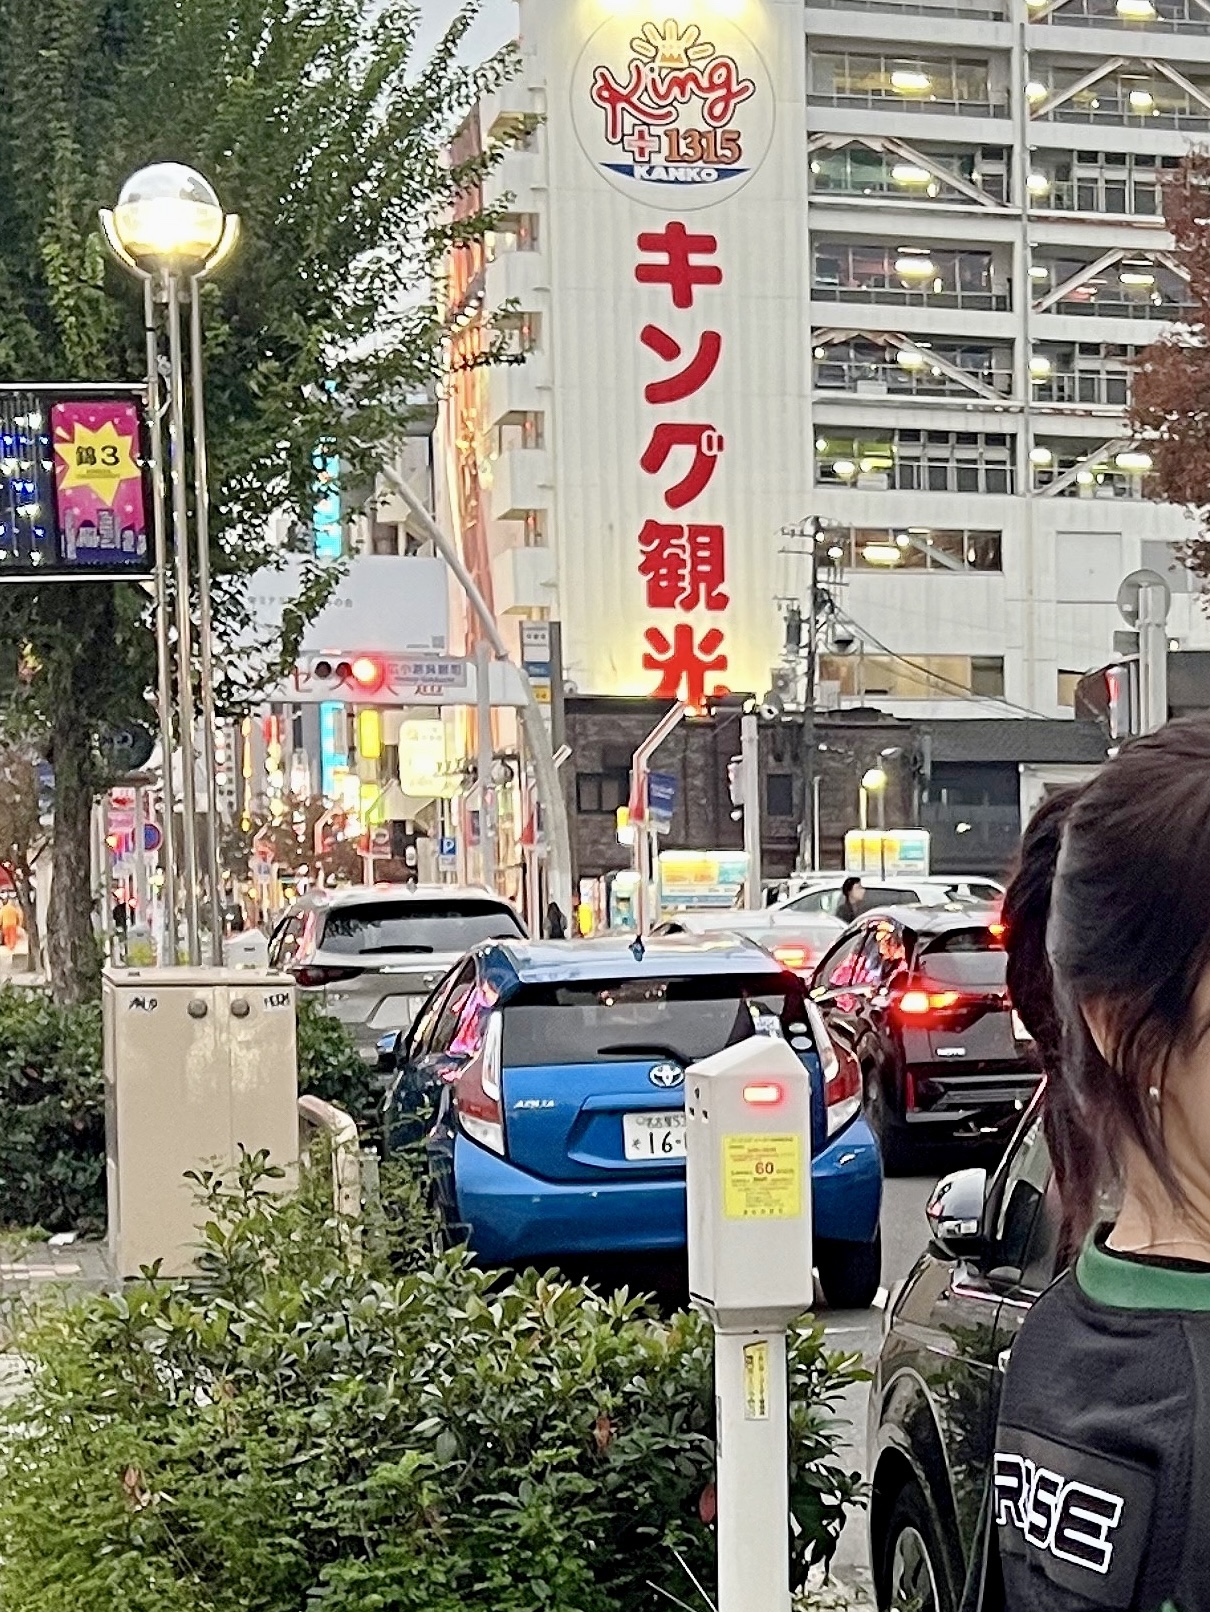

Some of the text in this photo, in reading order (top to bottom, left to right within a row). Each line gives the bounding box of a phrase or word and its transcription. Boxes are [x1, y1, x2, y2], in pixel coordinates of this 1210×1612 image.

[592, 56, 755, 144] King
[634, 164, 719, 183] KANKO
[634, 220, 730, 714] キング観光
[755, 1161, 775, 1175] 60
